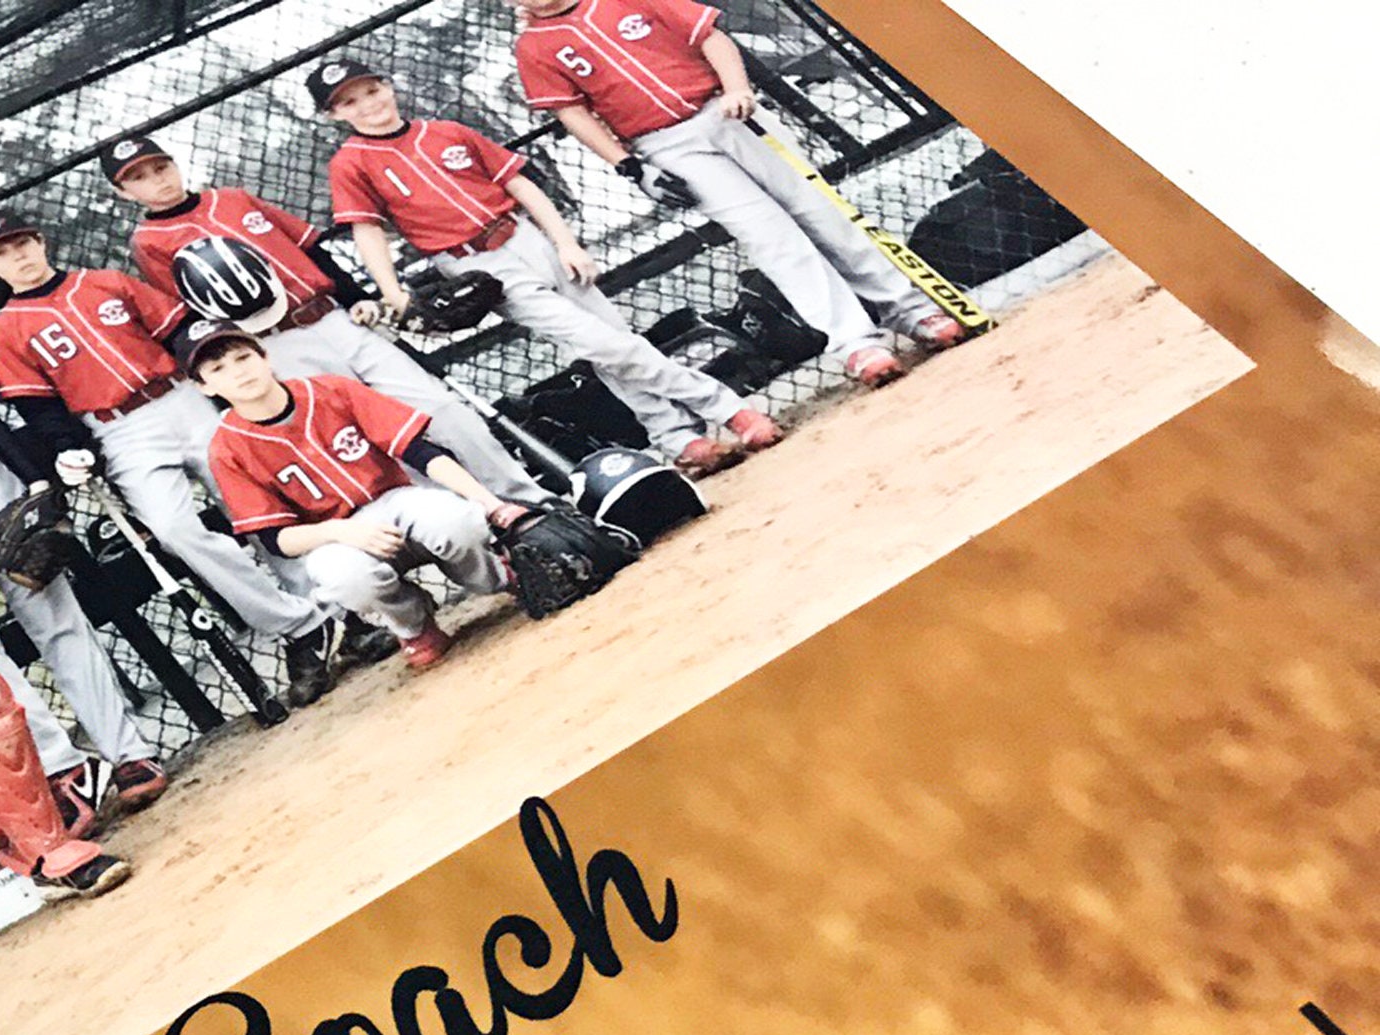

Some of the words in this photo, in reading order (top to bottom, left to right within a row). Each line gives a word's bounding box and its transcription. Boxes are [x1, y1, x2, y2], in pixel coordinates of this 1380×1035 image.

[555, 45, 593, 78] 5
[385, 167, 411, 197] 1
[865, 224, 978, 319] EASTON
[28, 321, 79, 370] 15
[276, 462, 324, 501] 7
